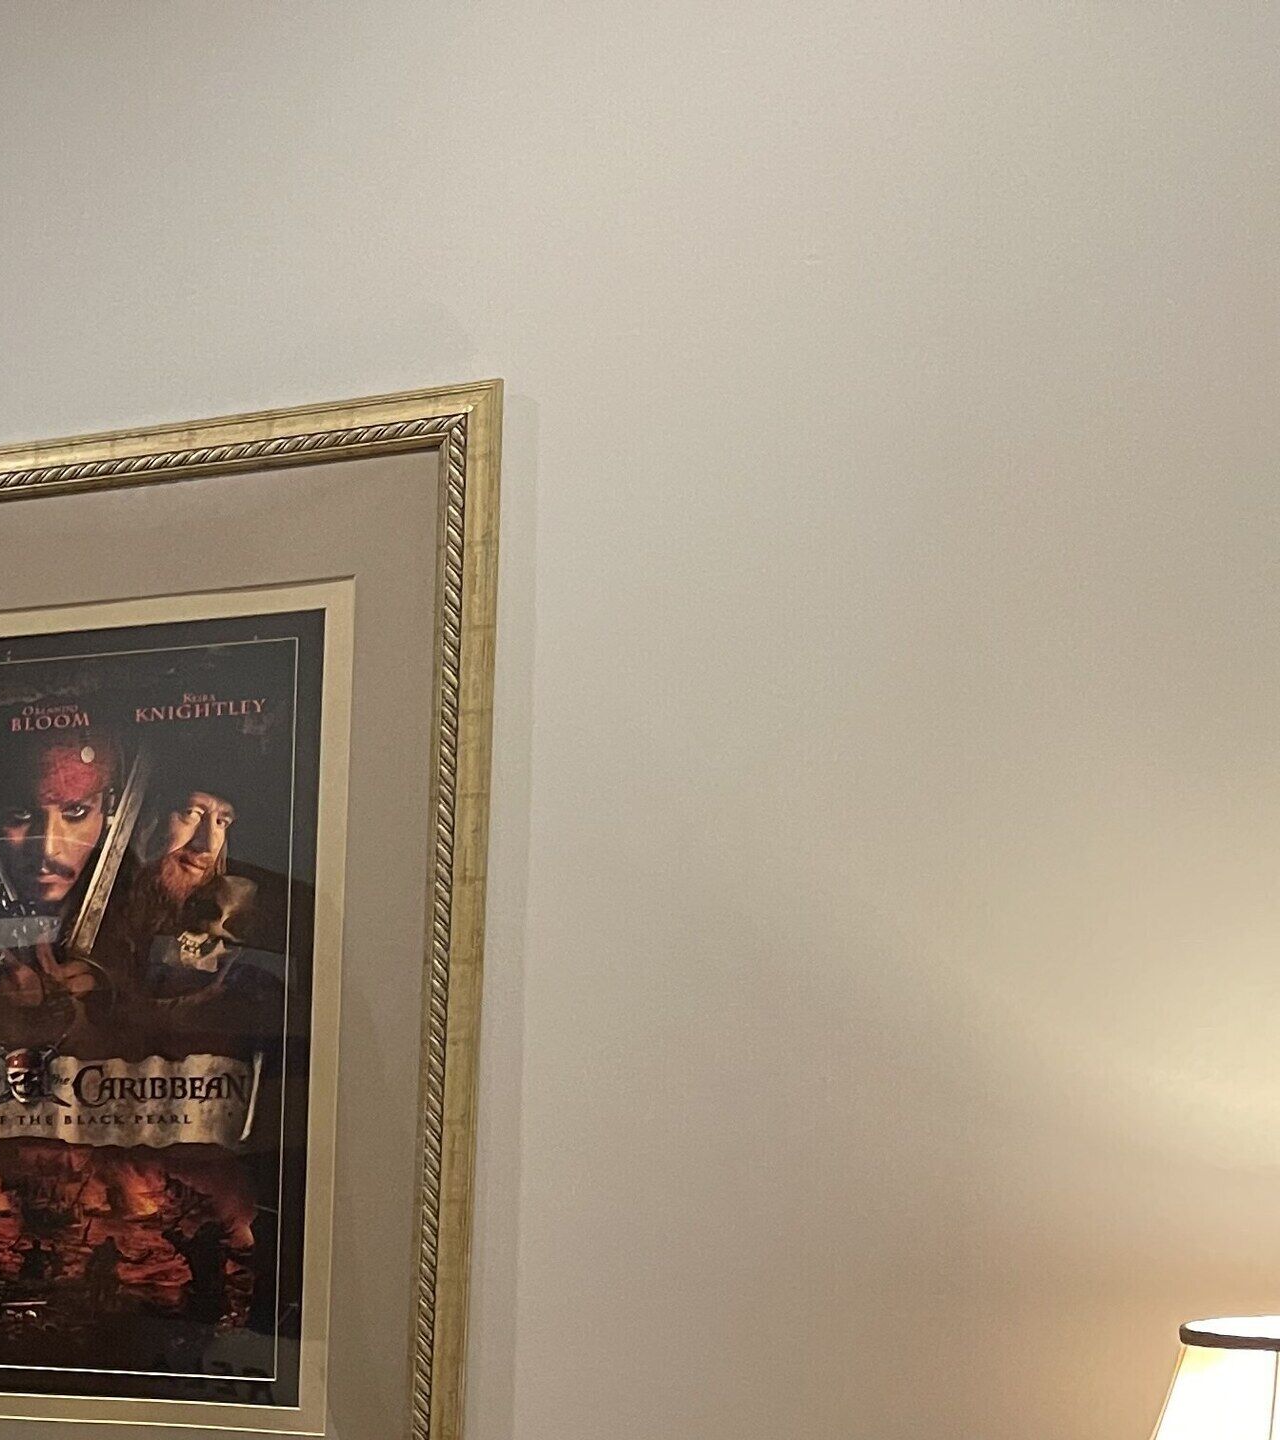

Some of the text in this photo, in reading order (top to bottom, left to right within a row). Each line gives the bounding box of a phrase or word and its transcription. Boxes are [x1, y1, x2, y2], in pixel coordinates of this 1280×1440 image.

[135, 698, 267, 723] KNIGHTLEY
[11, 712, 91, 732] BLOOM
[72, 1065, 250, 1109] CARIBBEAN
[16, 1115, 54, 1126] THE
[64, 1114, 127, 1126] BLACK
[134, 1113, 194, 1125] PEARL
